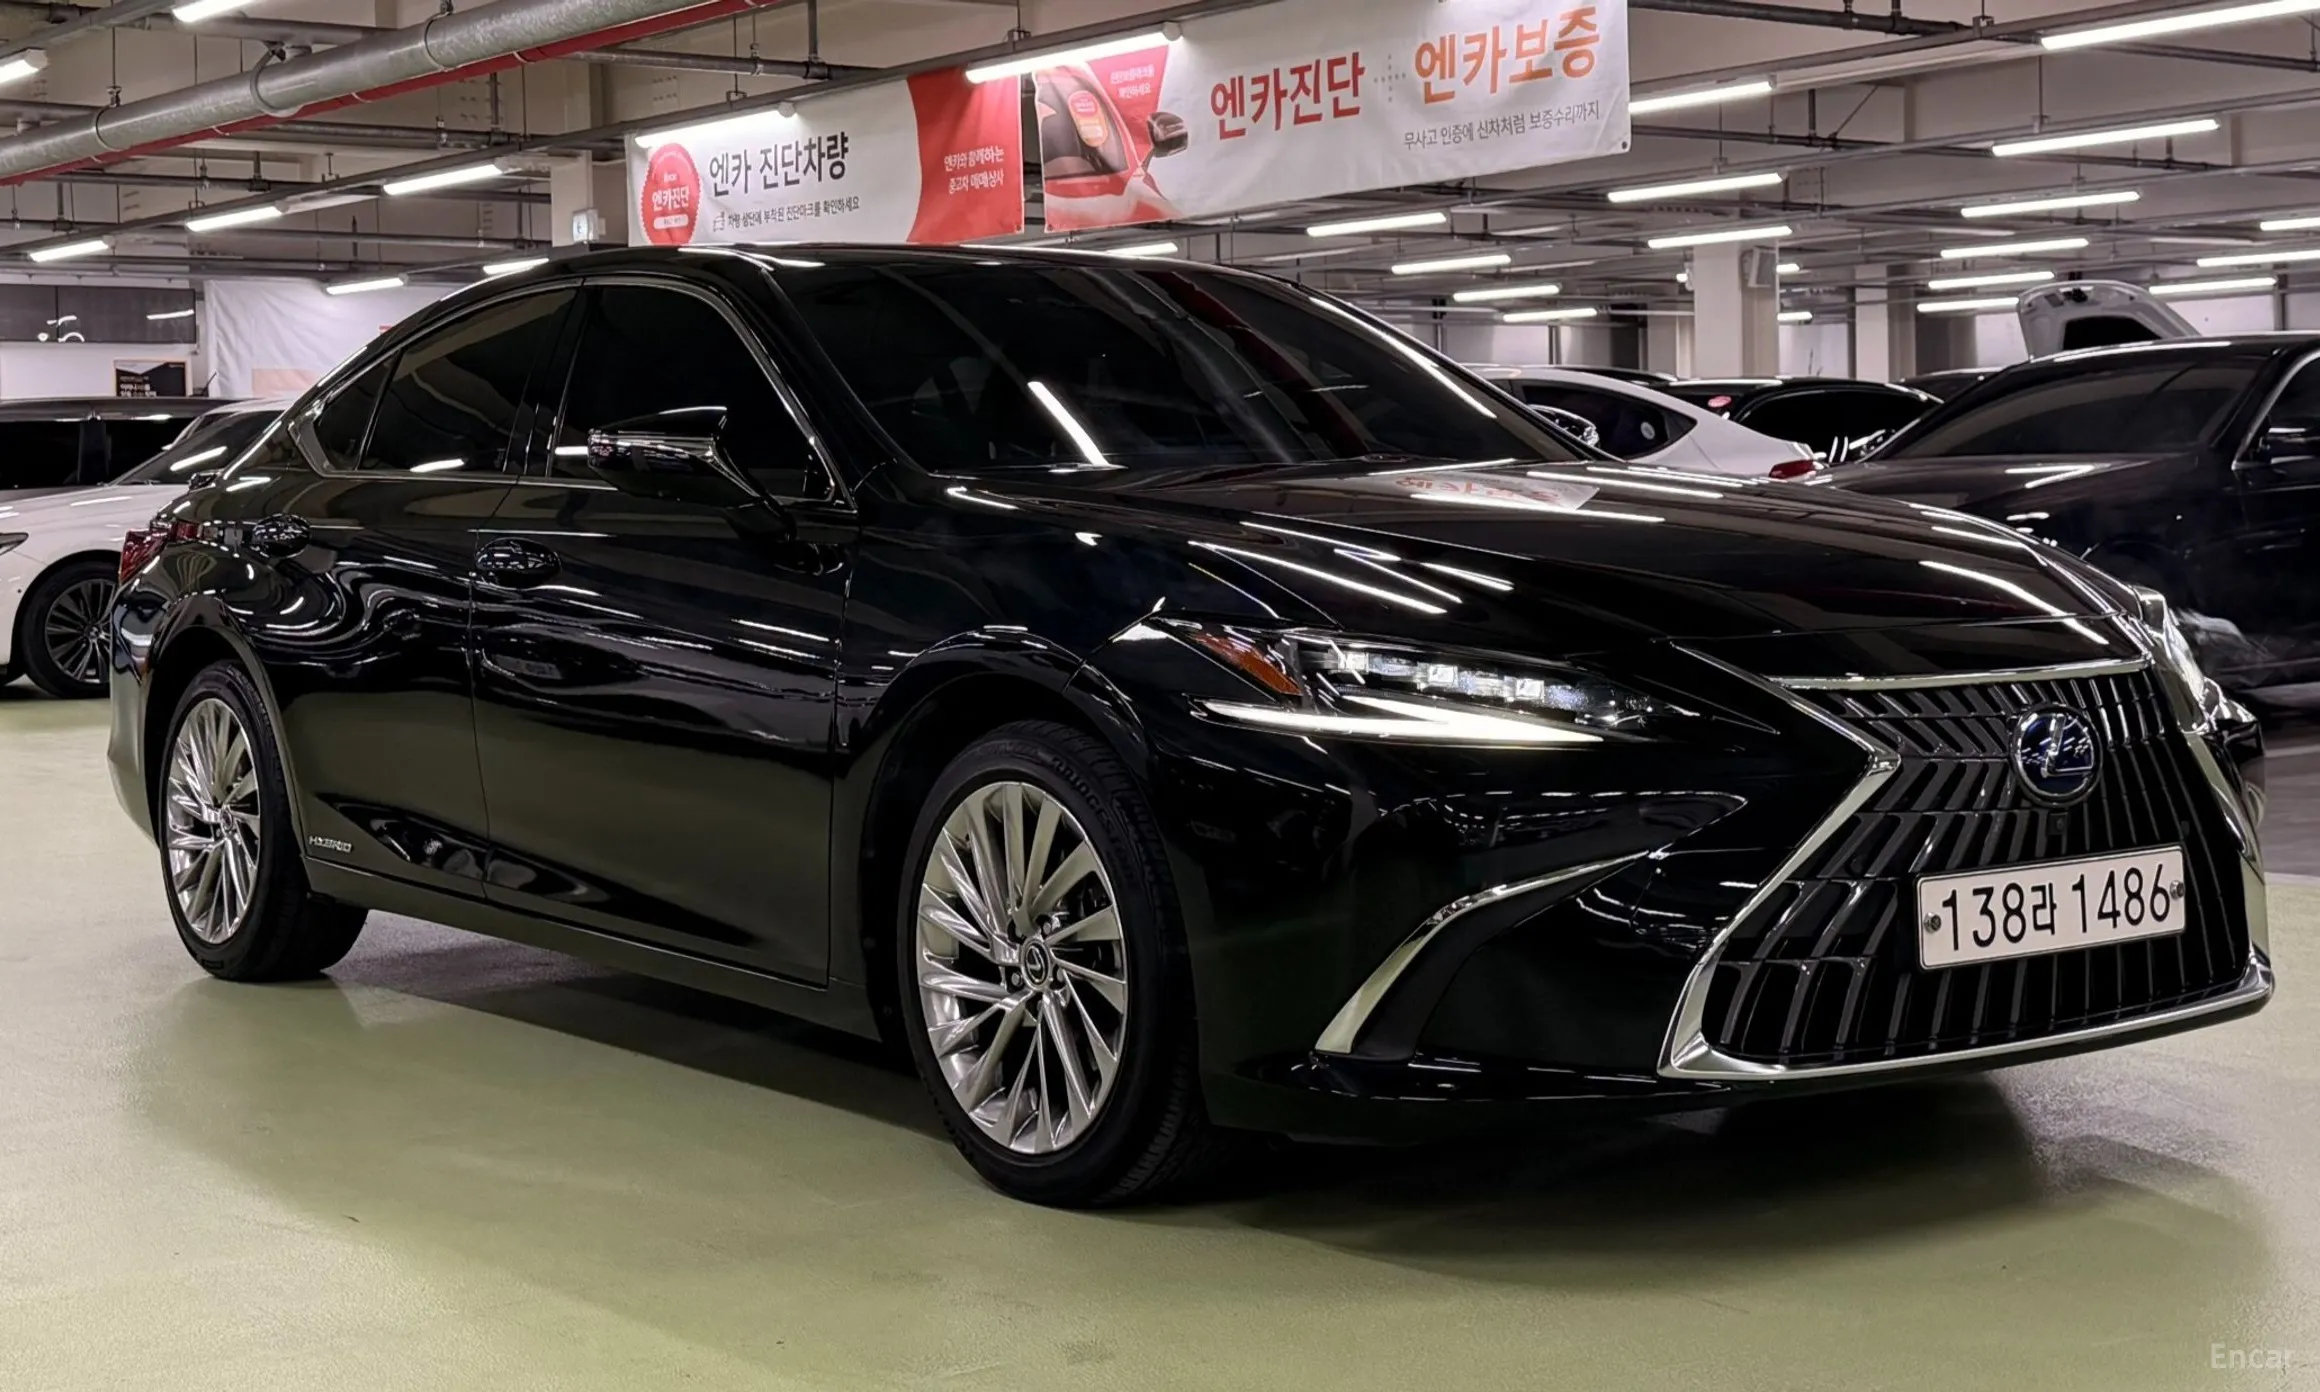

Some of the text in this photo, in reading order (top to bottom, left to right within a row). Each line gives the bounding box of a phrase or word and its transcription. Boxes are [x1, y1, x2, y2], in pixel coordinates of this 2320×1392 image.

[1415, 6, 1600, 105] 엔카보증
[1210, 51, 1366, 140] 엔카진단
[1404, 99, 1600, 150] 무사고 인증에 신차처럼 보증수리까지
[651, 186, 690, 213] 엔카진단
[709, 149, 752, 197] 엔카
[759, 131, 849, 190] 진단차량
[1942, 863, 2170, 951] 138라 1486
